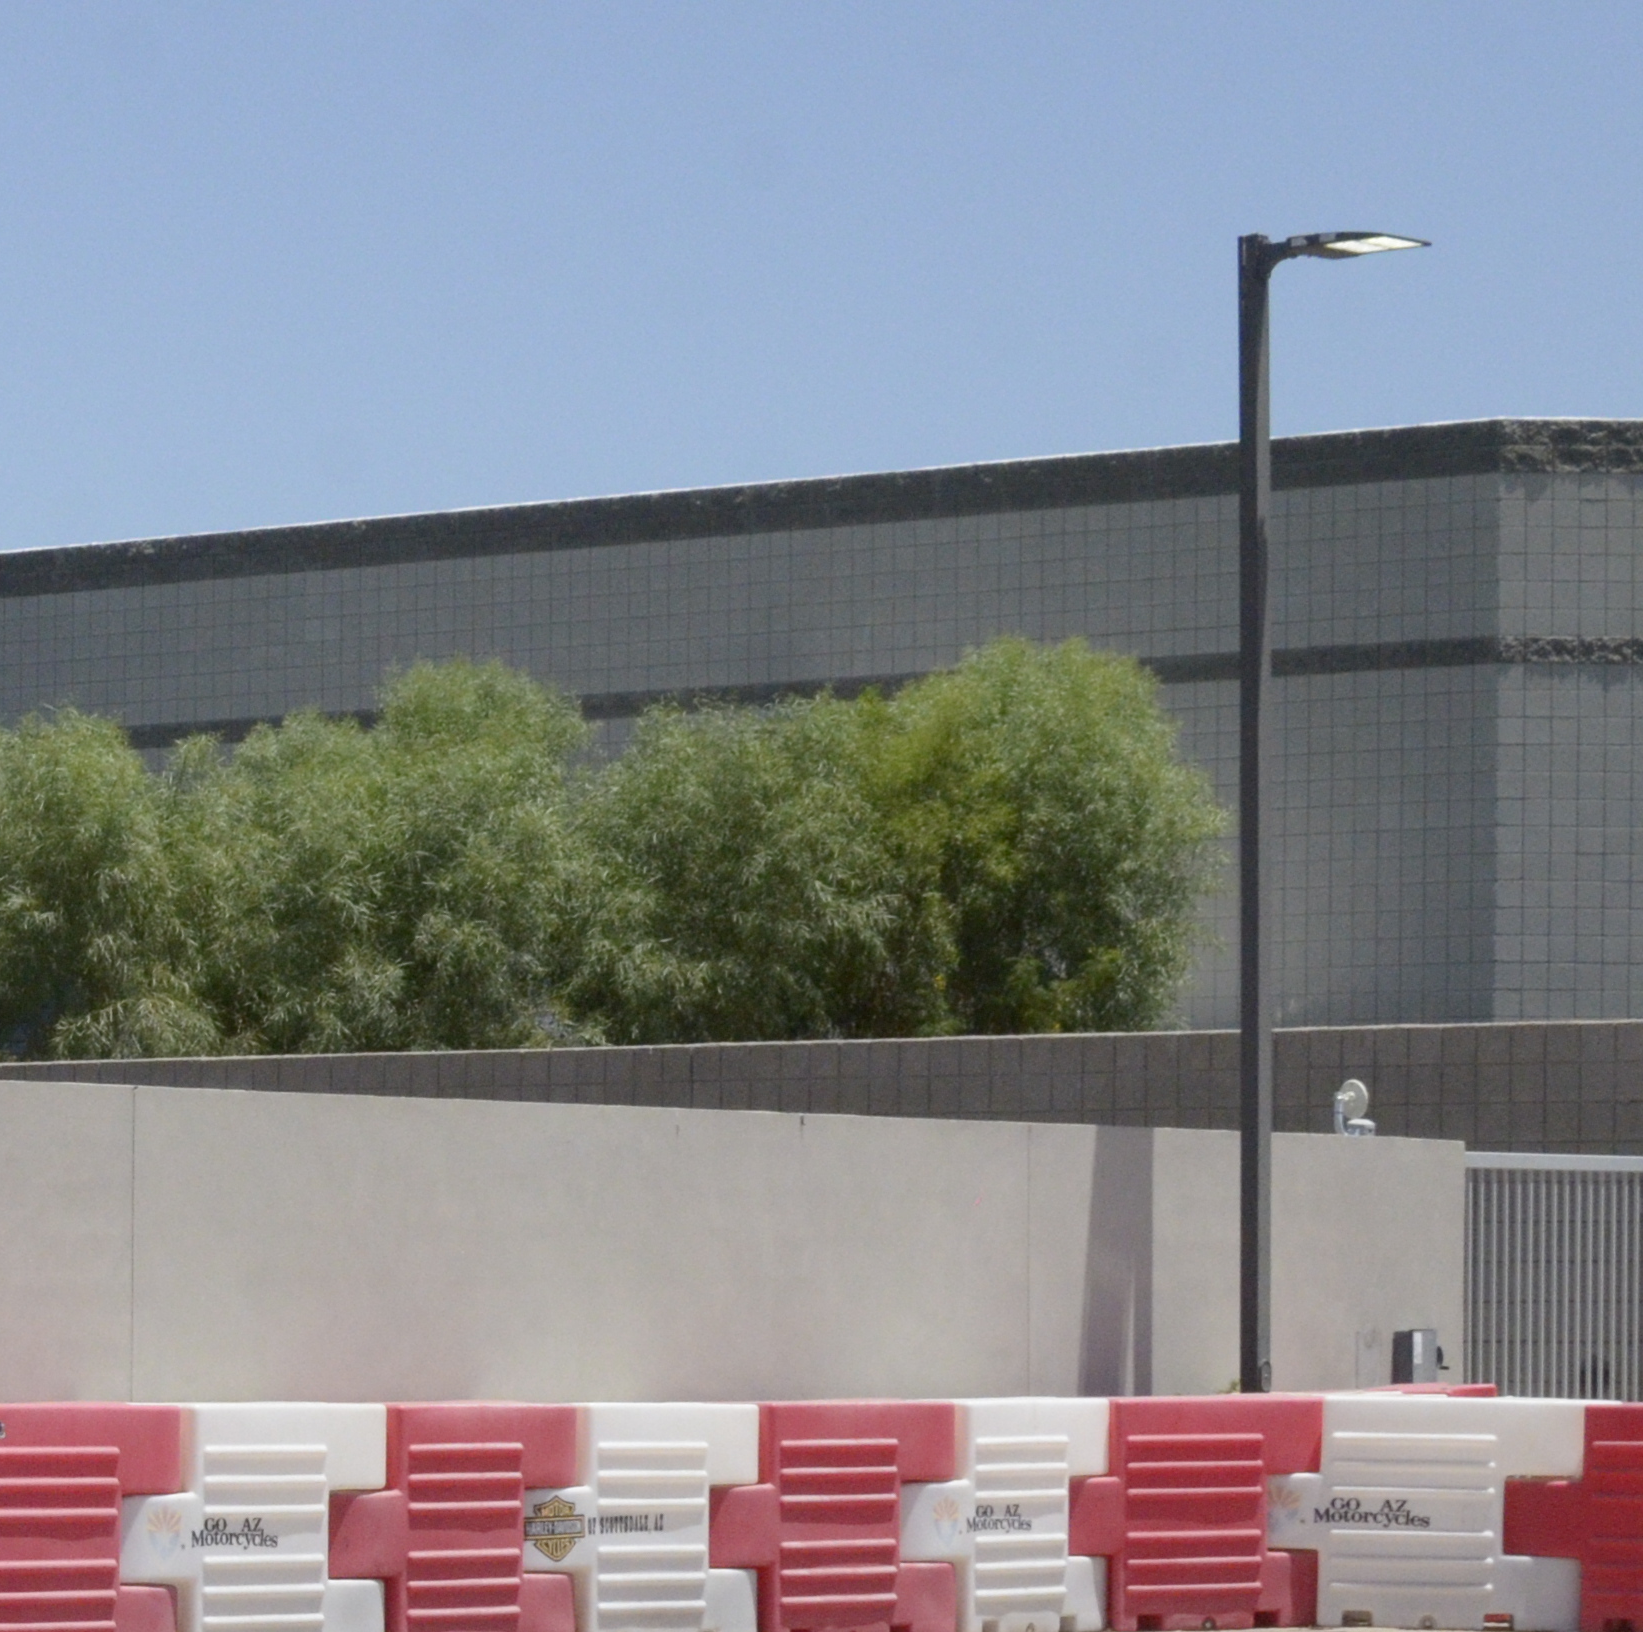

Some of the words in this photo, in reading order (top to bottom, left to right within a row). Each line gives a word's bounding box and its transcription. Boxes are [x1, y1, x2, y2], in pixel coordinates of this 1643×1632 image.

[976, 1505, 993, 1517] GO
[1004, 1504, 1020, 1517] AZ
[1330, 1497, 1360, 1511] GO
[1380, 1499, 1408, 1512] AZ
[204, 1517, 227, 1532] GO
[241, 1517, 262, 1532] AZ
[966, 1515, 1032, 1533] Motorcycles
[1313, 1508, 1431, 1528] Motorcycles
[191, 1529, 278, 1549] Motorcycles
